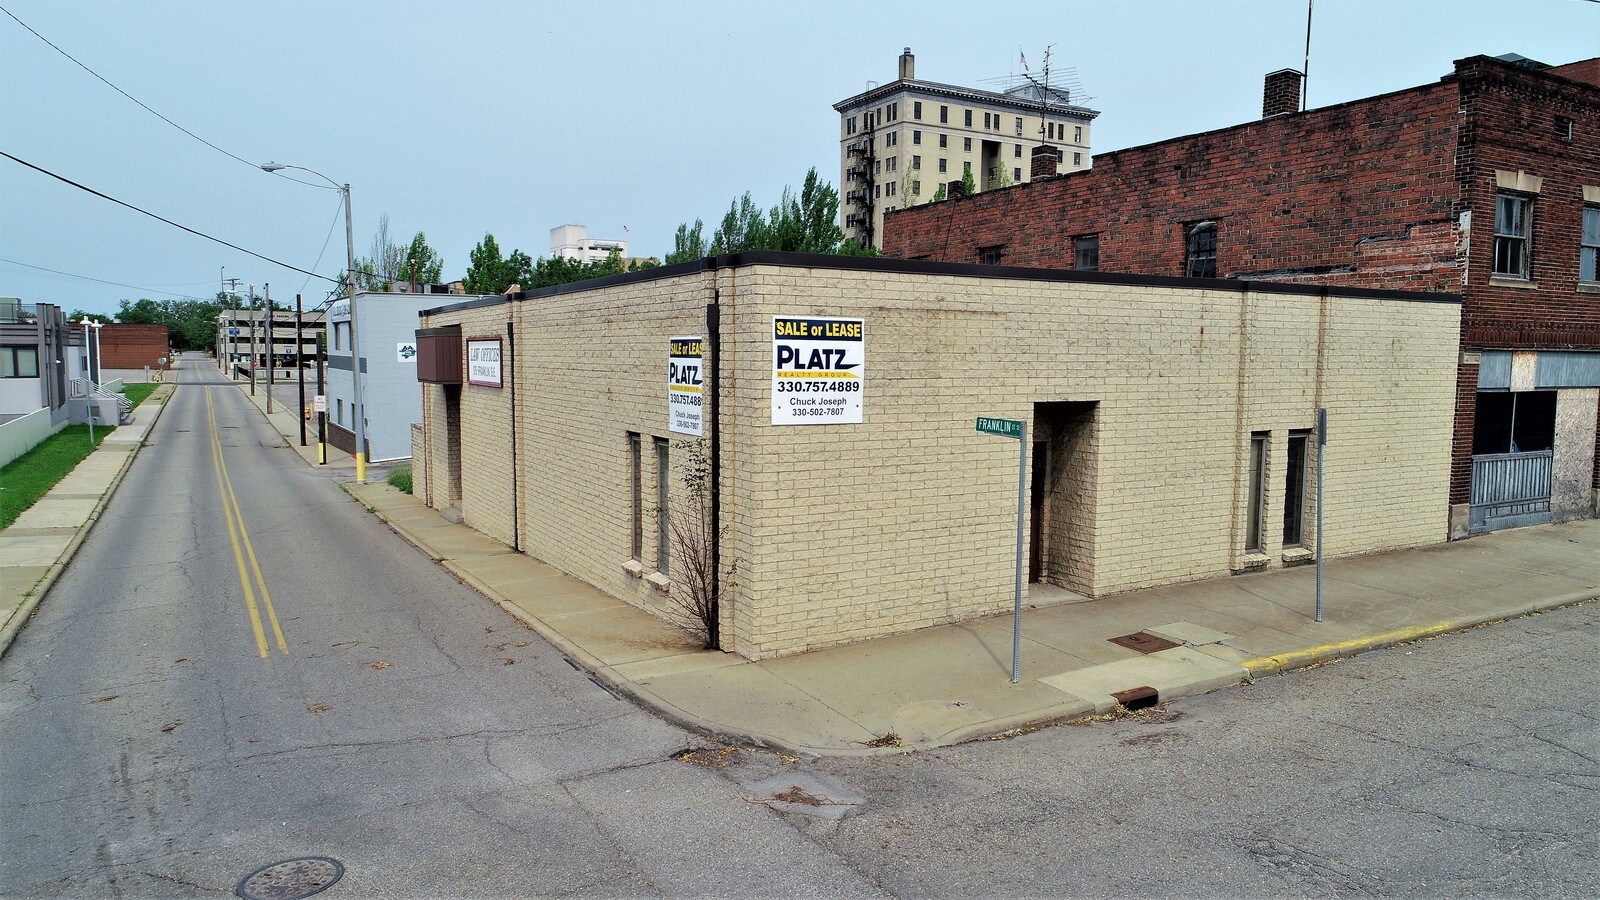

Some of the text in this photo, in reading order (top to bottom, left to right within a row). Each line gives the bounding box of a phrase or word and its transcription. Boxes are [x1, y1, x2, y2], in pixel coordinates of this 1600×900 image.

[776, 321, 861, 337] SALE or LEASE
[471, 348, 499, 362] LAW OFFICES
[671, 342, 702, 355] SALE or LEAS
[777, 345, 861, 370] PLATZ
[670, 362, 702, 385] PLATZ
[777, 382, 860, 392] 330.757.4889
[790, 397, 847, 406] Chuck Joseph
[686, 411, 700, 421] Joseph
[792, 408, 844, 416] 330-502-7807
[979, 419, 1011, 432] FRANKLIN
